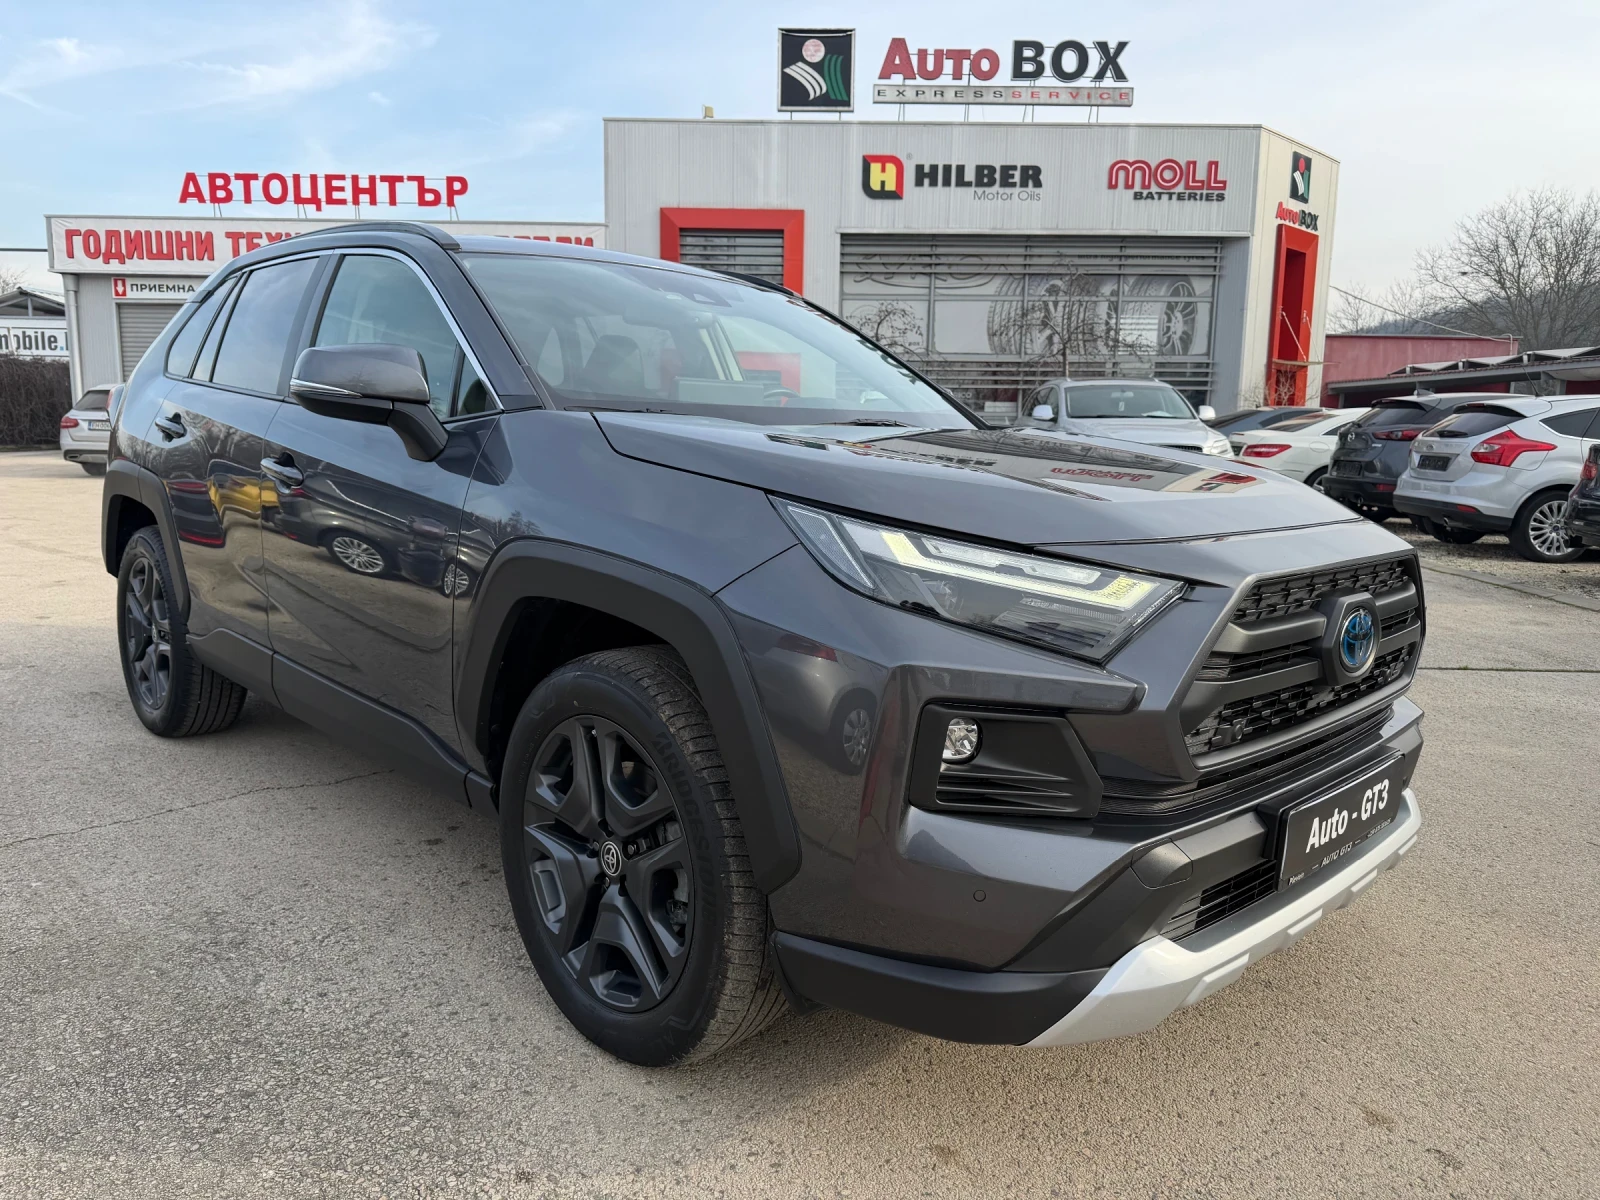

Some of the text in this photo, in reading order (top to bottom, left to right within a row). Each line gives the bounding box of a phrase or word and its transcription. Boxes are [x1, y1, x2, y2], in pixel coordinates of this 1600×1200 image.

[1011, 40, 1131, 82] BOX
[915, 164, 1042, 188] HILBER
[1107, 158, 1228, 191] MOLL
[179, 172, 468, 211] АВТОЦЕНТЪР
[973, 190, 1041, 201] Motor Oils
[1133, 191, 1226, 202] BATTERIES
[1298, 209, 1319, 231] BOX
[65, 229, 214, 264] ГОДИШНИ
[130, 283, 196, 293] ПРИЕМНА
[1305, 808, 1349, 854] Auto
[1361, 778, 1390, 821] GT3
